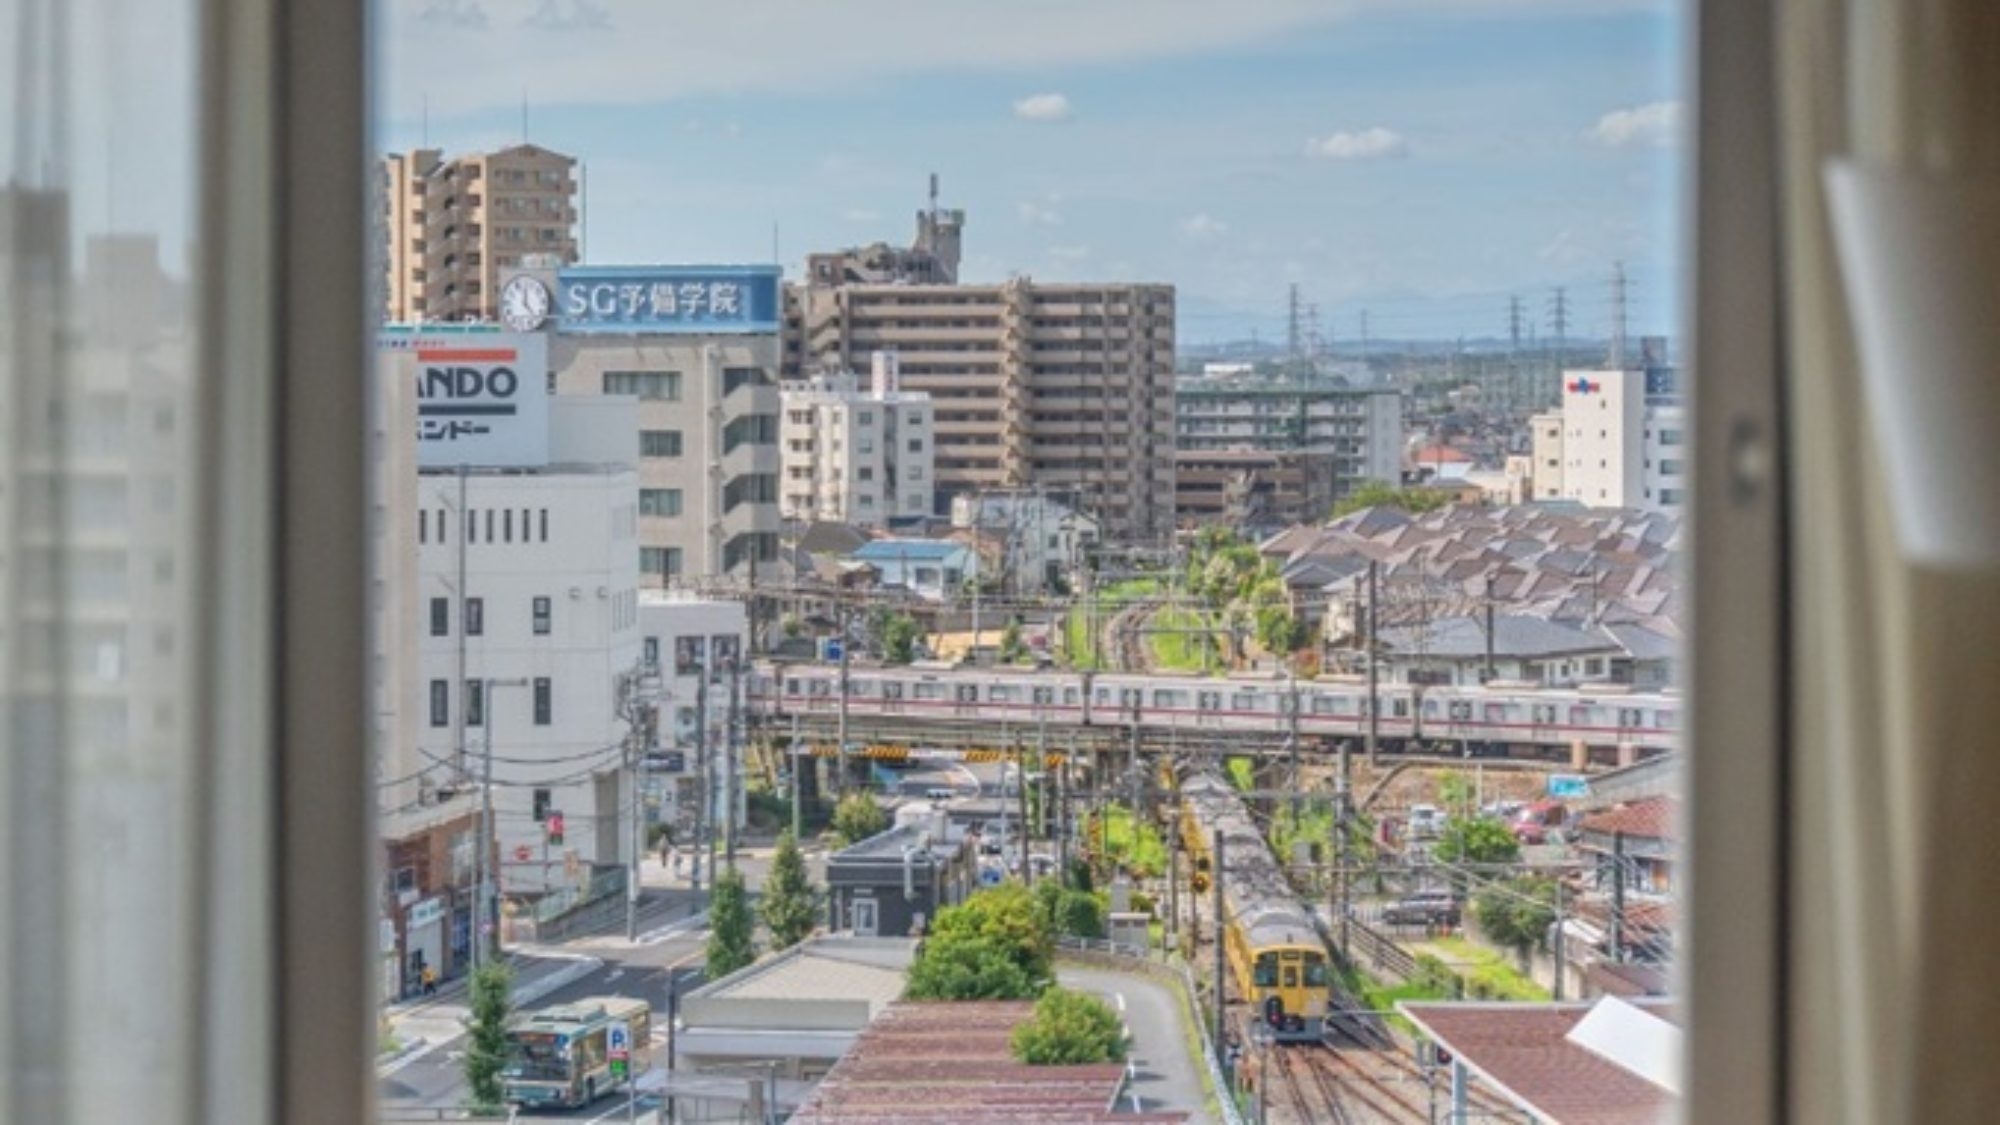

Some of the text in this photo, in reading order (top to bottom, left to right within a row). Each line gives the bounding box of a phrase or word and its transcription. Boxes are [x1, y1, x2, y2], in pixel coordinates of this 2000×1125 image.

[567, 282, 739, 315] SG予備学院
[418, 367, 518, 398] NDO
[418, 421, 490, 440] ンドー
[612, 1029, 625, 1048] P
